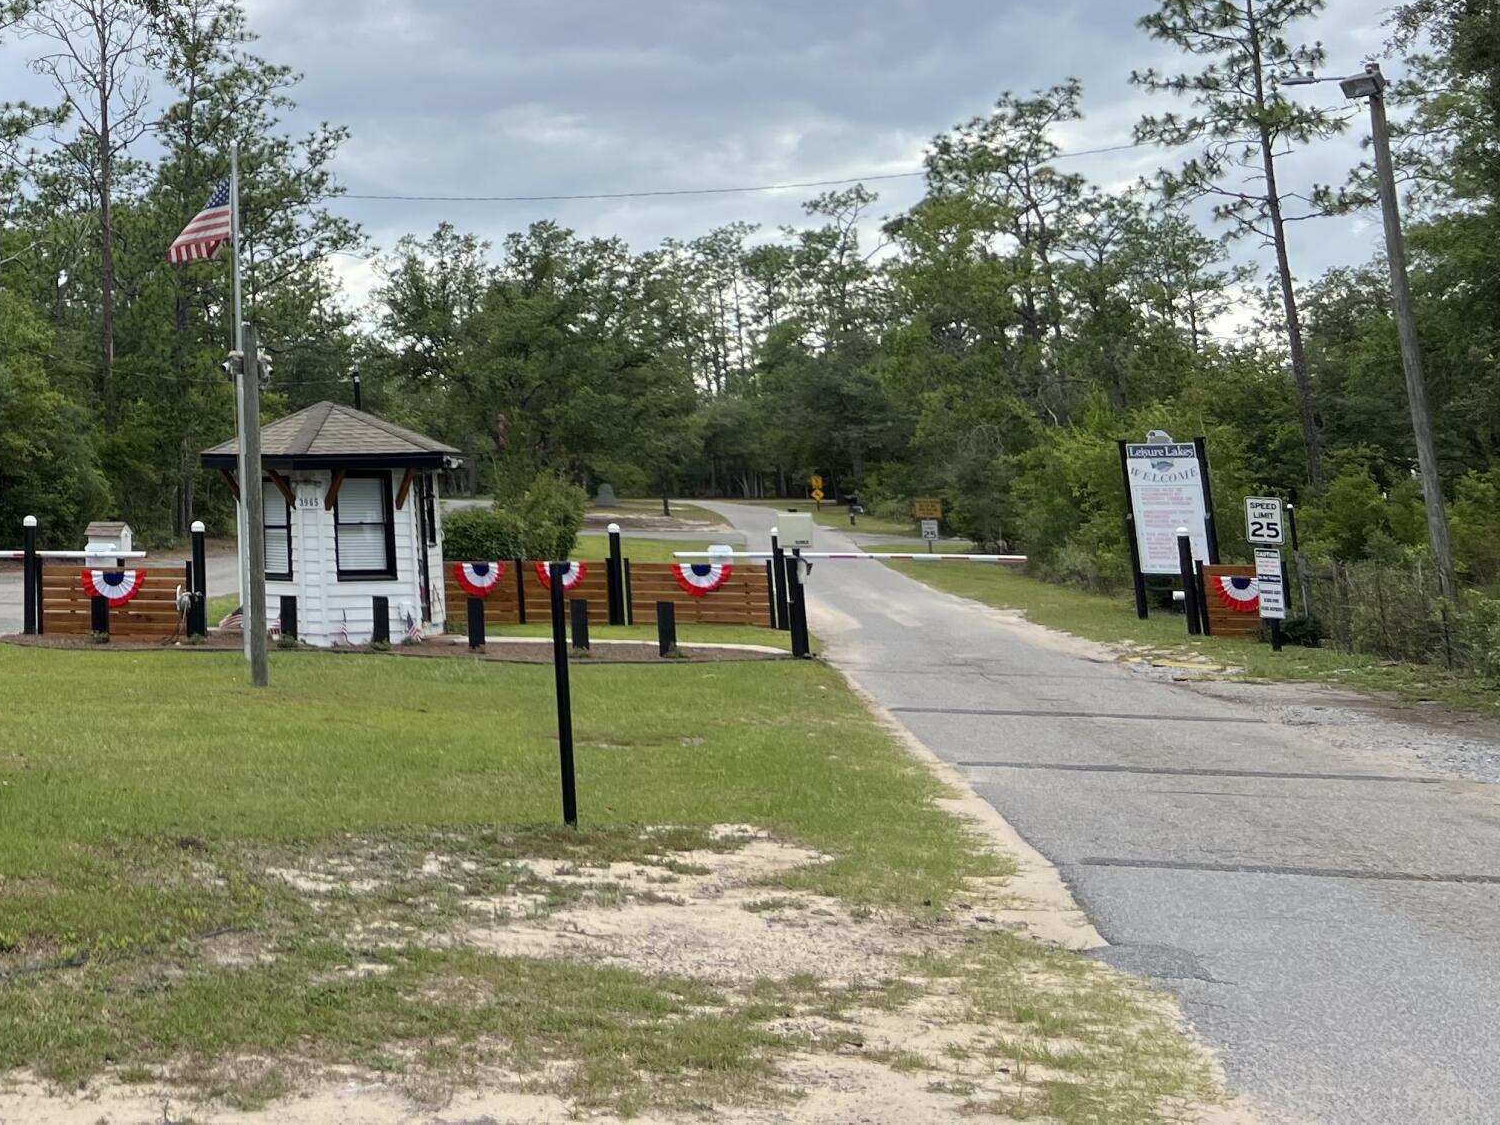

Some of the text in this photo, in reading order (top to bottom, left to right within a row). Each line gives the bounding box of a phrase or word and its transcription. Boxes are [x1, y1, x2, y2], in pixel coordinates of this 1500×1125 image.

[1128, 445, 1194, 459] Leisure Lakes
[1130, 466, 1198, 484] WELCOME
[1250, 502, 1277, 510] SPEED
[923, 530, 937, 539] 25
[1251, 521, 1280, 538] 25
